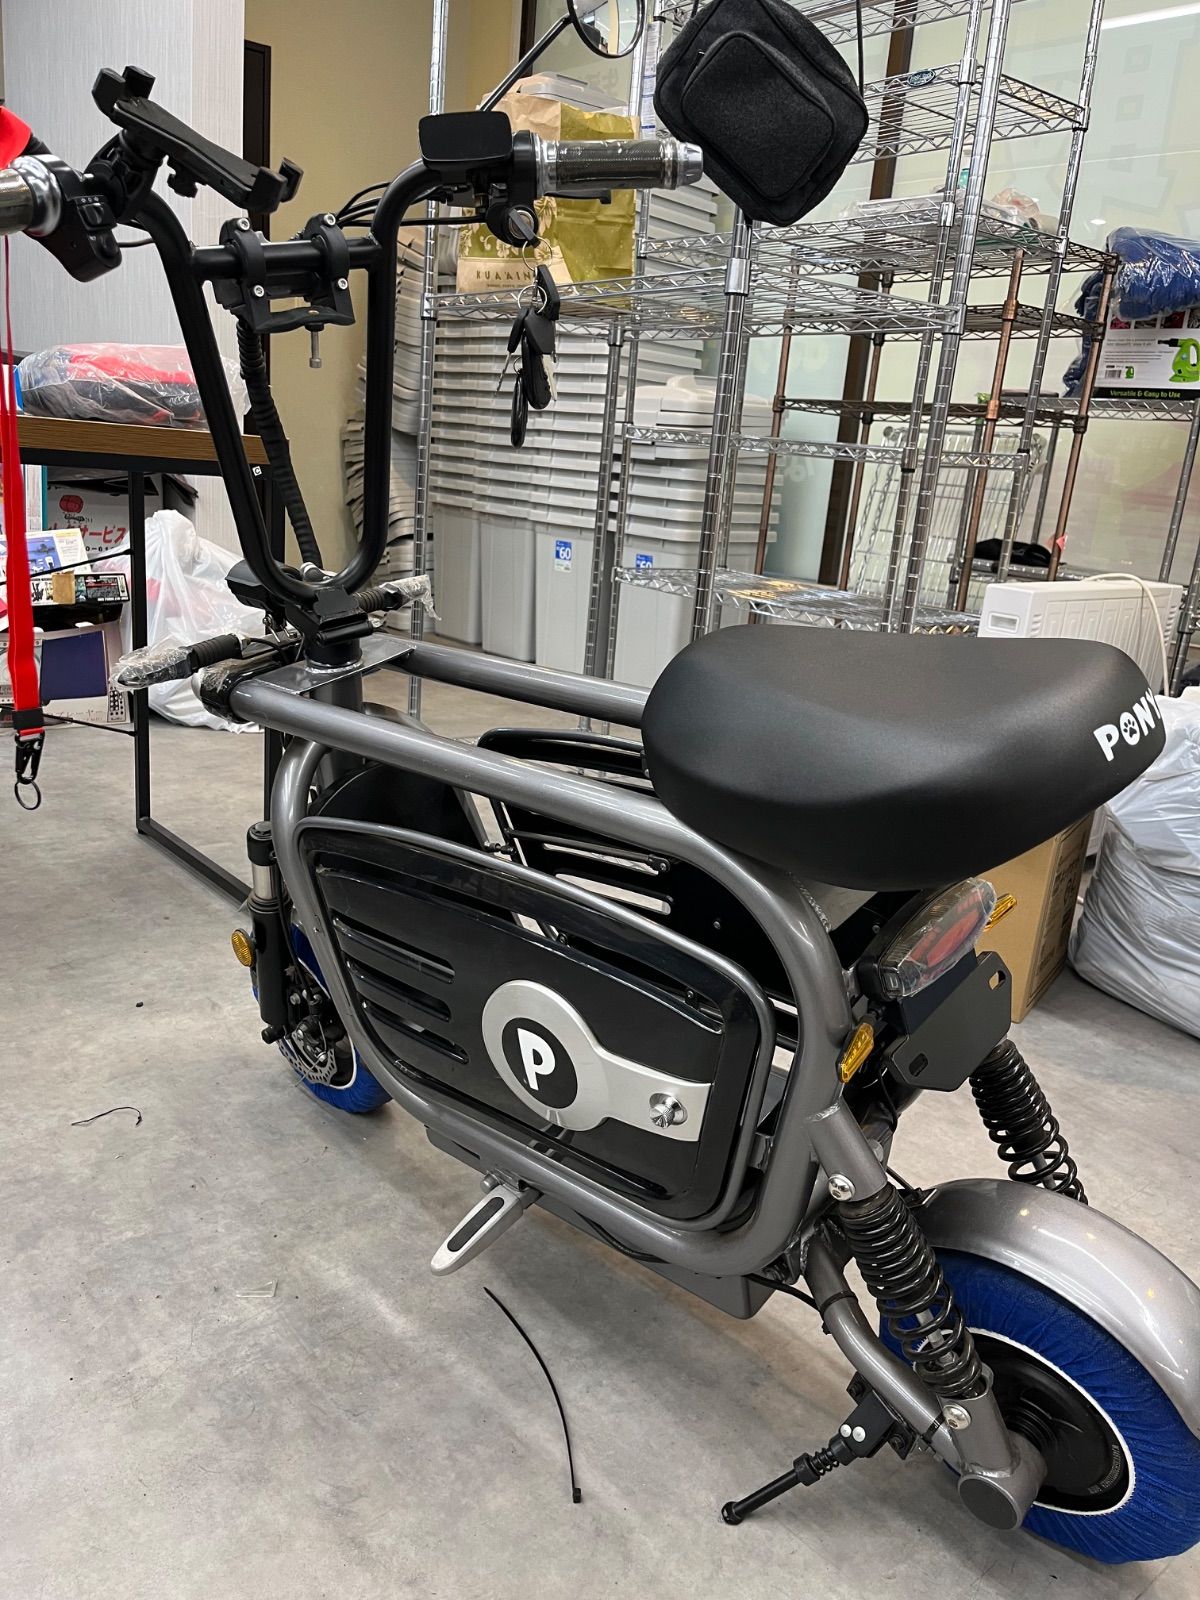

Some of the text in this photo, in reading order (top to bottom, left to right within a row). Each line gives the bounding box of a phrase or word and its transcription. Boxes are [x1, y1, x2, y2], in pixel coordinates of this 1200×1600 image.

[1143, 390, 1160, 398] Easy
[560, 547, 571, 559] 60
[1093, 687, 1161, 762] PONY
[517, 1027, 556, 1091] P
